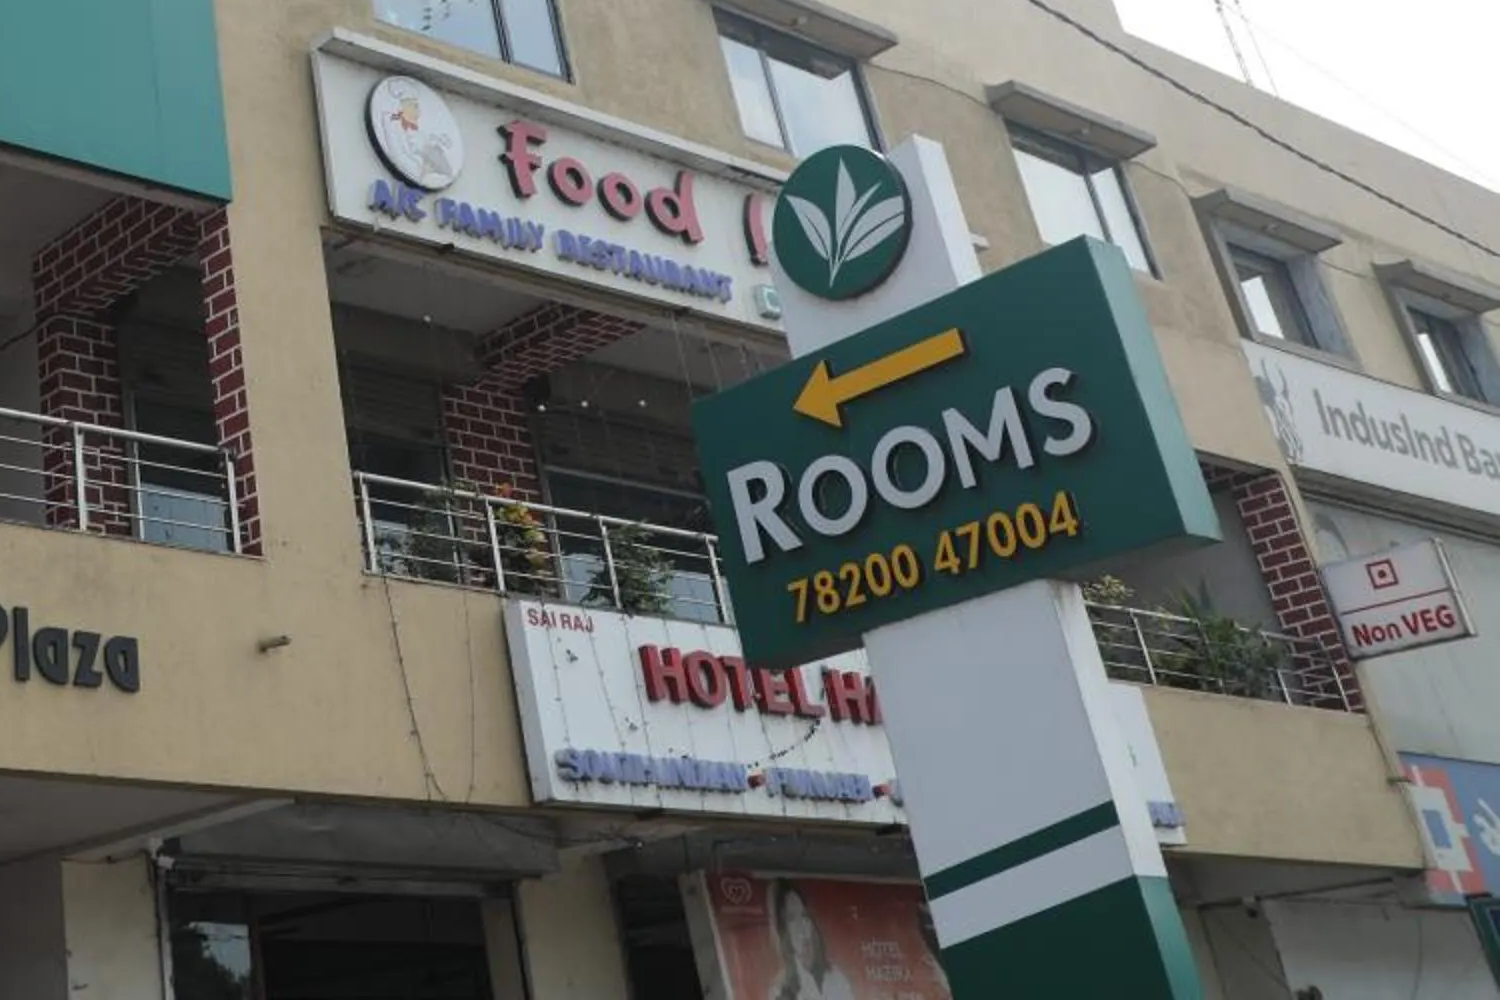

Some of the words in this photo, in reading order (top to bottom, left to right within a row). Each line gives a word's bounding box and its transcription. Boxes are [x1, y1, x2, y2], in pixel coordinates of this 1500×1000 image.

[496, 119, 704, 248] Food
[435, 196, 545, 255] FAMILY
[554, 229, 733, 304] RESTAURANT
[727, 367, 1093, 565] ROOMS
[1312, 387, 1459, 470] IndusInd
[1456, 431, 1500, 480] Ba
[787, 544, 920, 624] 78200
[934, 490, 1080, 576] 47004
[526, 607, 557, 629] SAI
[559, 611, 594, 634] RAJ
[1350, 622, 1403, 648] Non
[1400, 604, 1457, 635] VEG
[638, 643, 826, 719] HOTEL
